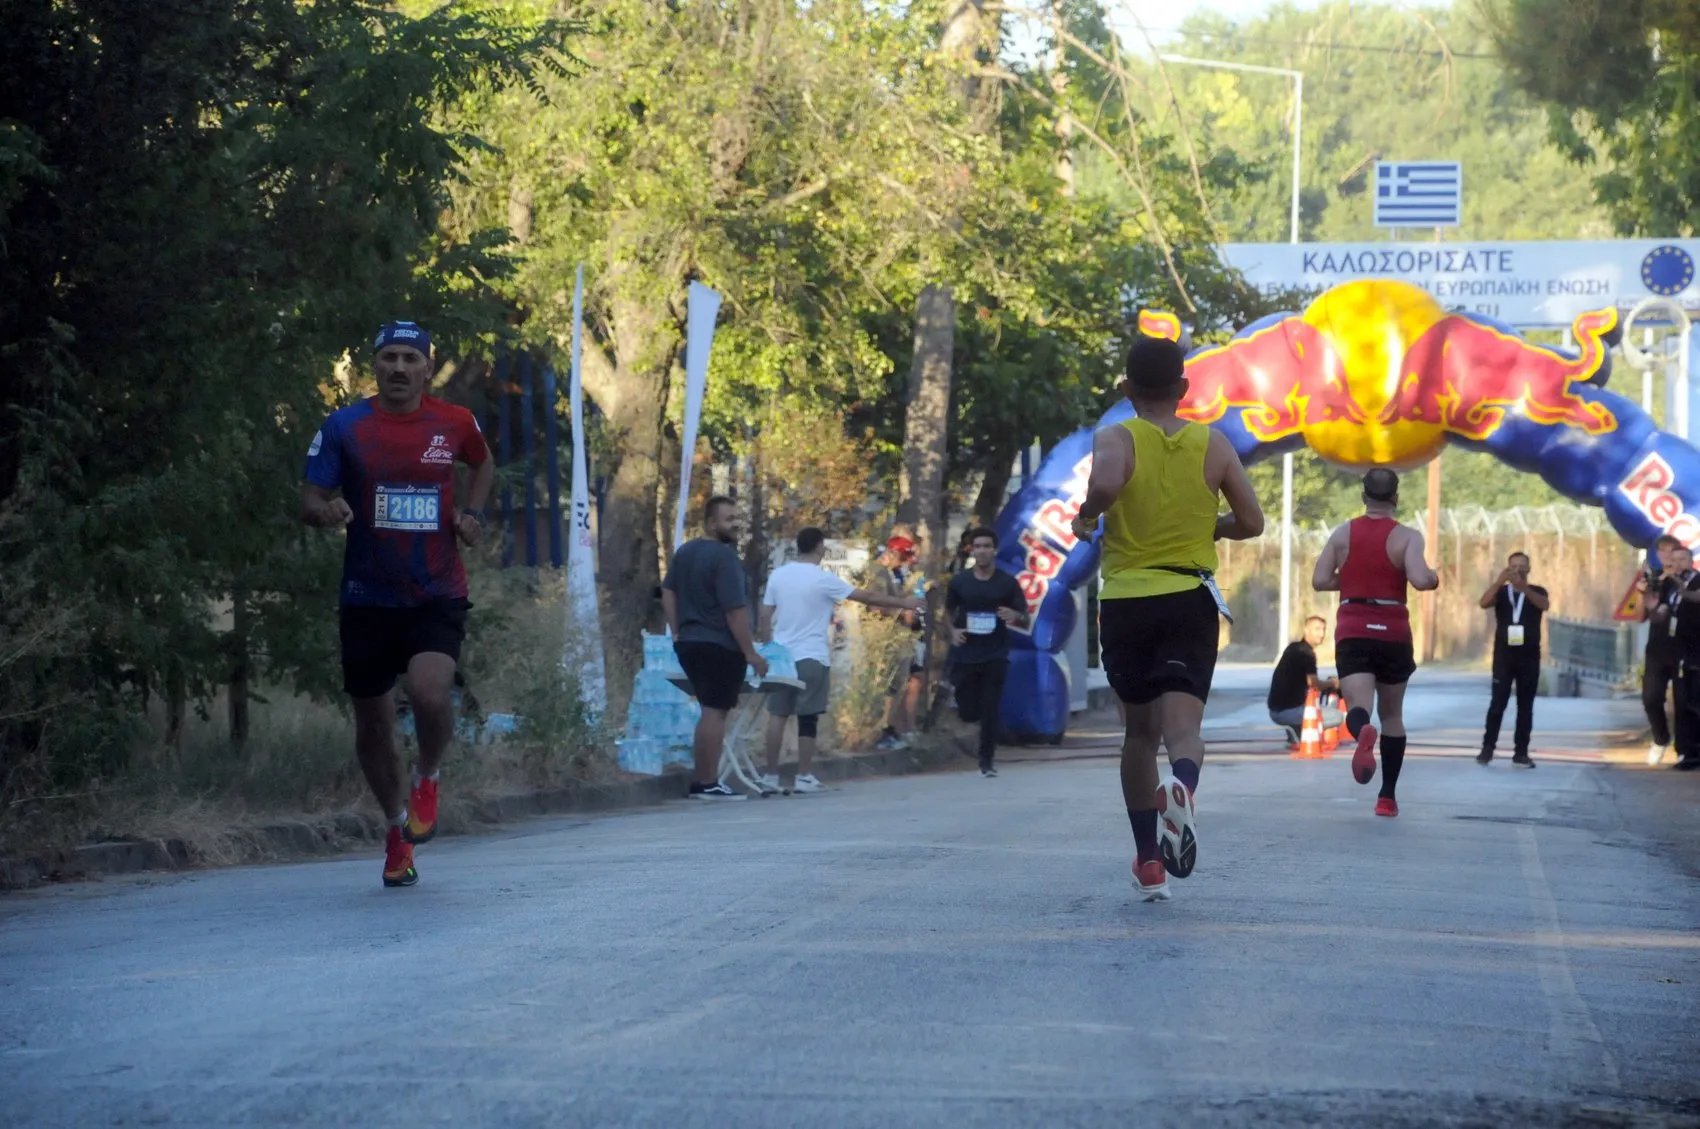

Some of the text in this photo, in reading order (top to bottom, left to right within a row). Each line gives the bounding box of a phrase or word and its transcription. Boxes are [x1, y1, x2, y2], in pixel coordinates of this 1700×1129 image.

[1302, 250, 1513, 273] ΚΑΛΩΣΟΡΙΣΑΤΕ
[1436, 278, 1540, 296] ΕΥΡΩΠΑΪΚΗ
[1547, 279, 1610, 296] ΕΝΩΣΗ
[390, 496, 437, 520] 2186
